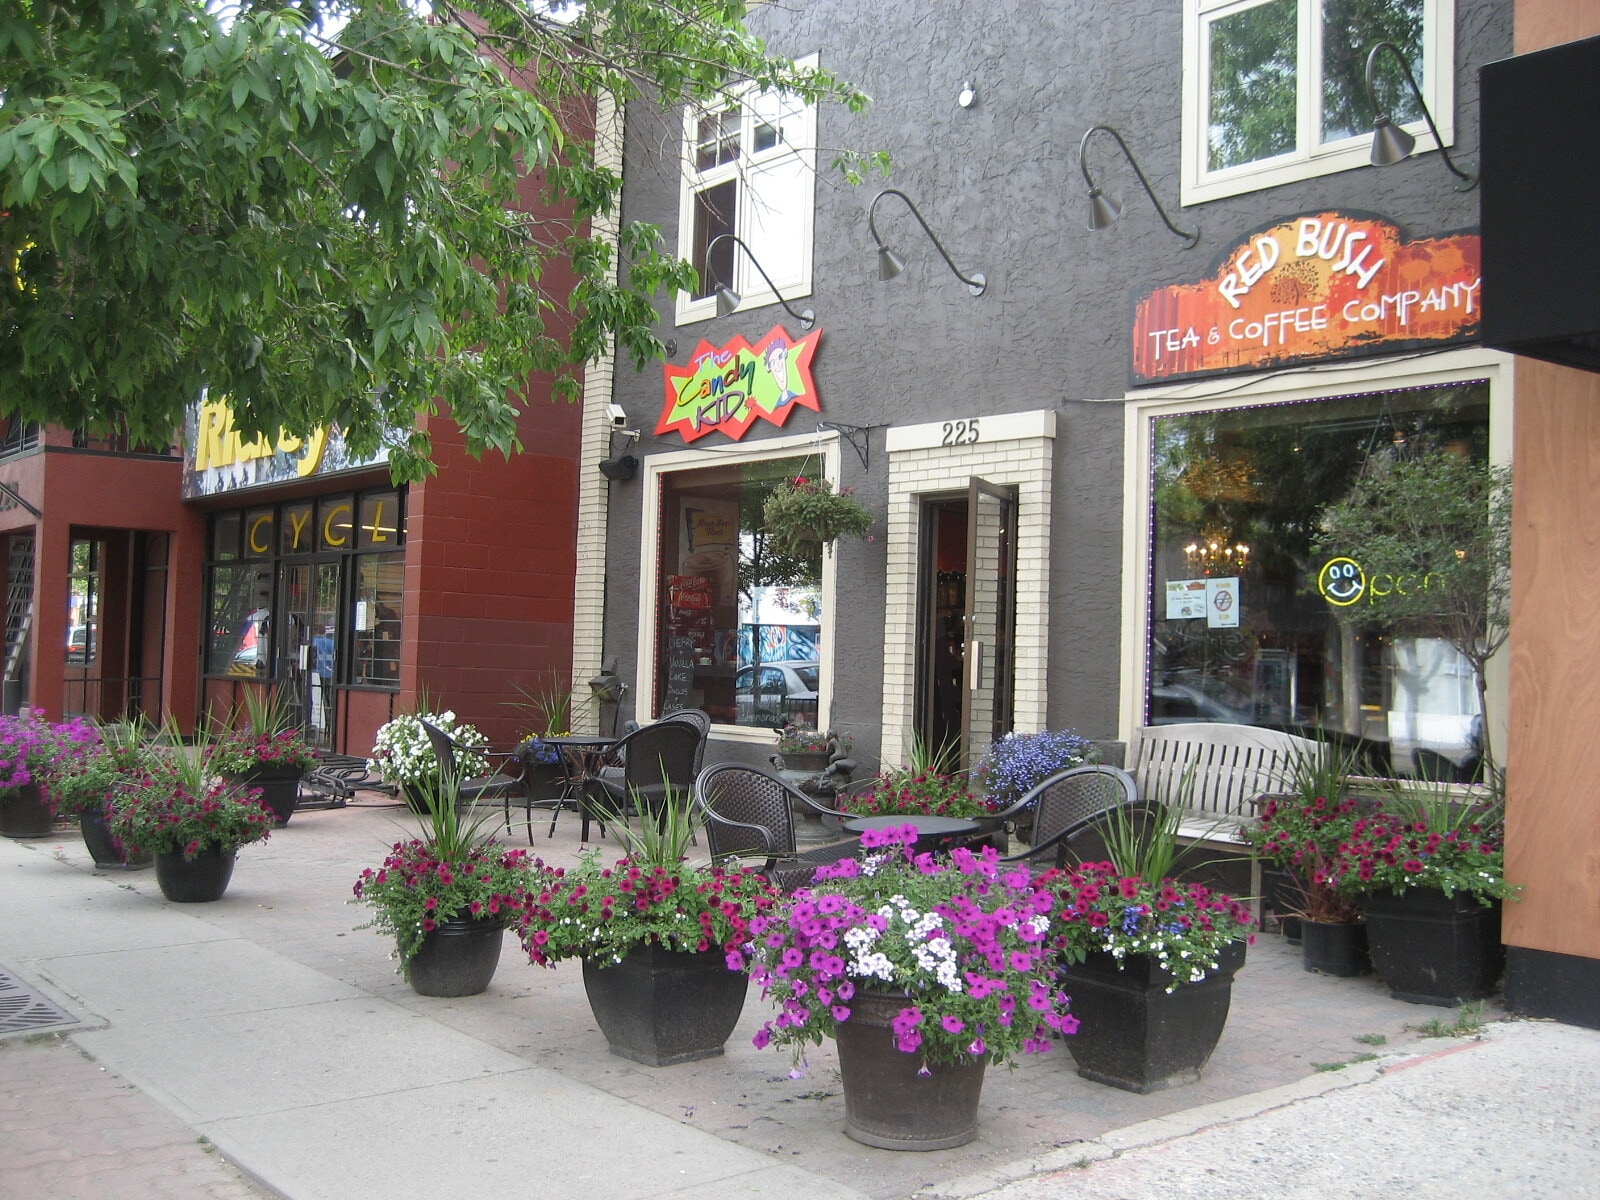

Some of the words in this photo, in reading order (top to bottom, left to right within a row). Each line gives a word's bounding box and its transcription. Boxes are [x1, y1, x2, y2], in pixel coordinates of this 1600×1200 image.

[1217, 235, 1281, 310] RED
[1296, 218, 1386, 291] BUSH
[694, 349, 732, 373] The
[1148, 329, 1201, 361] TEA
[1207, 326, 1221, 346] &
[676, 354, 756, 408] Candy
[695, 390, 746, 433] KID
[941, 418, 981, 447] 225
[668, 655, 695, 669] VANILLA
